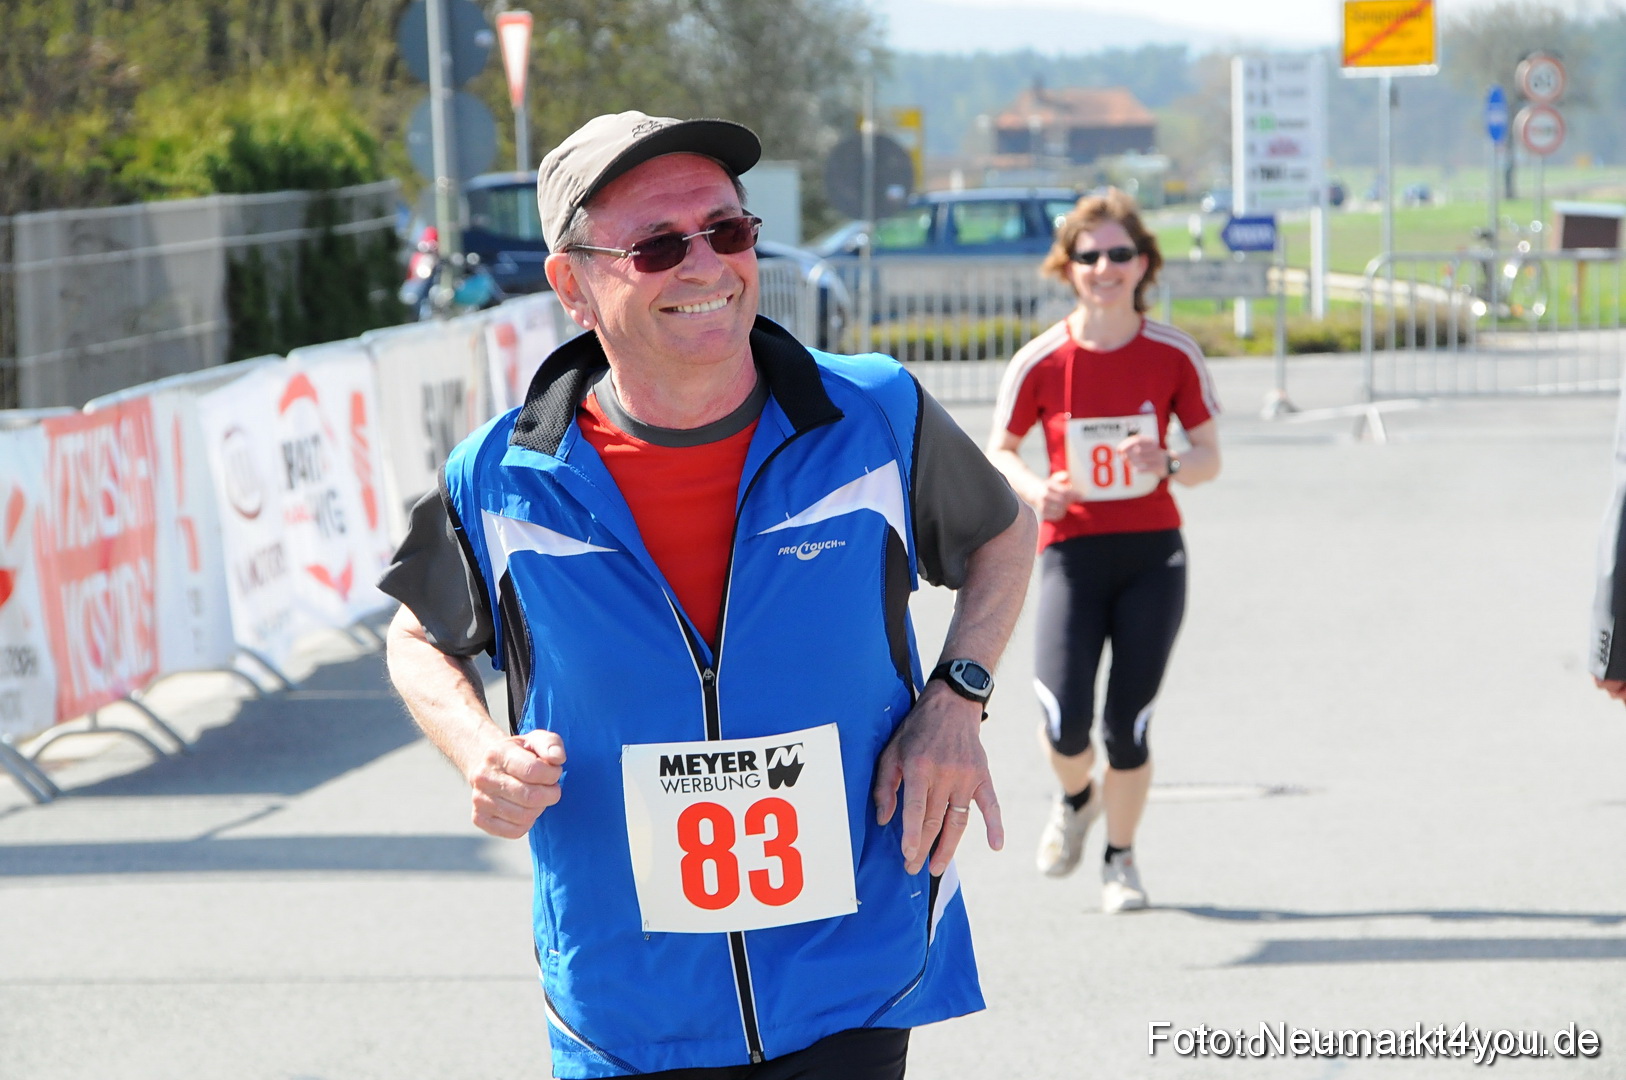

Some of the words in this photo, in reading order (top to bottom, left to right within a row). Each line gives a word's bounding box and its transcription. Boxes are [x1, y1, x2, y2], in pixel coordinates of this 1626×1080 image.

[659, 750, 759, 777] MEYER
[660, 773, 761, 794] WERBUNG
[677, 797, 804, 911] 83
